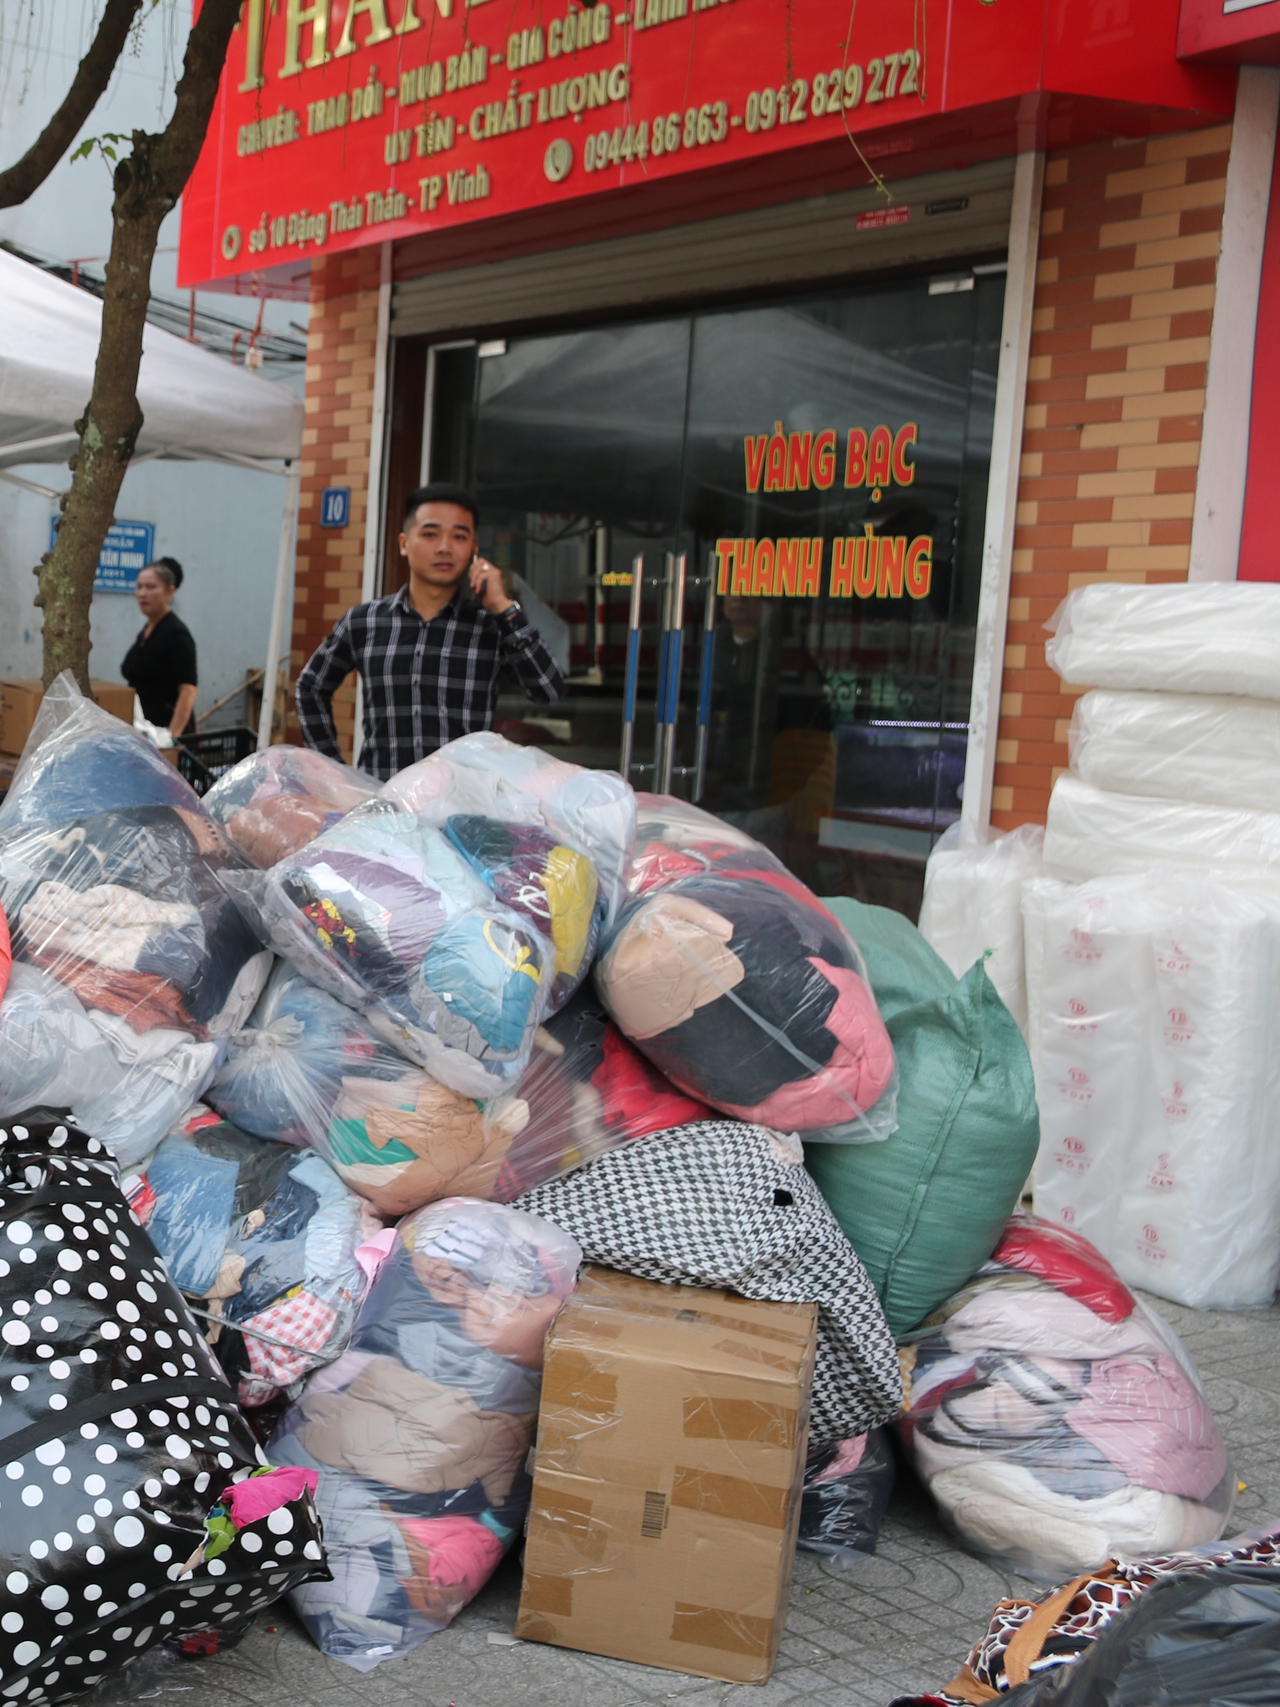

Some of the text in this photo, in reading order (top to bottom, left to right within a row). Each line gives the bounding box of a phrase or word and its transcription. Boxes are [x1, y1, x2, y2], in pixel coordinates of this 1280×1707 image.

[307, 92, 350, 136] TRAO
[400, 60, 444, 108] MUA
[446, 40, 489, 92] BÁN
[506, 25, 545, 72] GIA
[547, 3, 611, 59] CÔNG
[745, 78, 808, 133] 0912
[811, 64, 863, 117] 829
[865, 48, 921, 103] 272
[383, 128, 415, 166] UY
[469, 78, 537, 142] CHẤT
[537, 63, 631, 124] LƯỢNG
[248, 212, 268, 254] số
[271, 215, 287, 249] 10
[287, 209, 328, 251] Đặng
[330, 196, 365, 235] Thái
[419, 175, 443, 213] TP
[447, 163, 491, 206] Vinh
[743, 420, 918, 503] VÀNG BẠC
[326, 493, 344, 521] 10
[715, 523, 933, 599] THANH HÙNG
